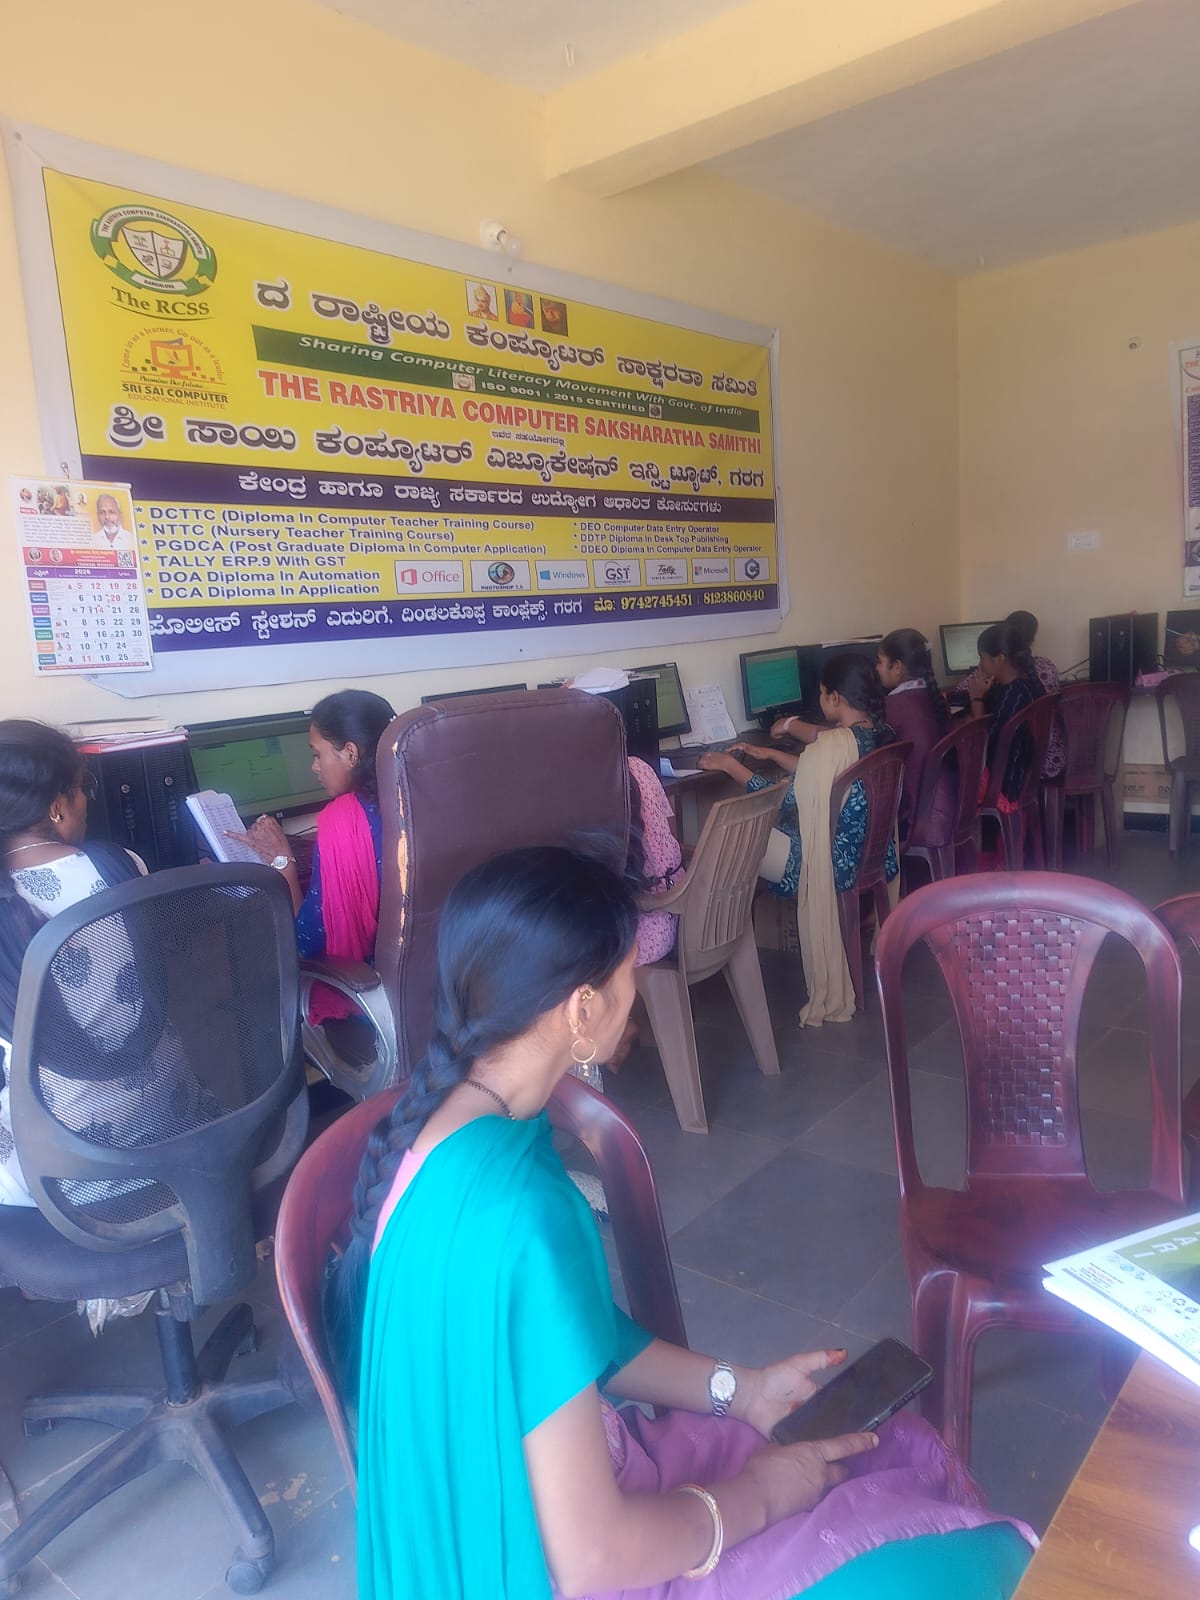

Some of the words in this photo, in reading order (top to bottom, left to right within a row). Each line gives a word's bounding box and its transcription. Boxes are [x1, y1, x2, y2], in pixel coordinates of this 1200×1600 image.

[111, 286, 150, 310] The
[156, 299, 210, 316] RCSS
[257, 280, 290, 310] ದ
[312, 293, 450, 344] ರಾಷ್ಟ್ರೀಯ
[466, 322, 605, 371] ಕಂಪ್ಯೂಟರ್
[617, 356, 704, 389] ಸಾಕ್ಷರತಾ
[712, 373, 757, 396] ಸಮಿತಿ
[299, 336, 384, 361] Sharing
[390, 352, 483, 375] Computer
[488, 367, 551, 386] Literacy
[555, 380, 631, 399] Movement
[636, 388, 665, 404] With
[668, 398, 697, 410] Govt.
[700, 405, 713, 414] of
[715, 406, 742, 416] India
[122, 384, 142, 393] SRI
[145, 385, 164, 396] SAI
[167, 389, 228, 403] COMPUTER
[128, 393, 184, 405] EDUCATIONAL
[481, 382, 506, 391] ISO
[511, 386, 541, 397] 9001
[554, 393, 583, 403] 2015
[587, 398, 646, 413] CERTIFIED
[258, 370, 321, 402] THE
[328, 380, 456, 420] RASTRIYA
[463, 400, 578, 433] COMPUTER
[585, 416, 705, 448] SAKSHARATHA
[709, 432, 761, 454] SAMITHI
[110, 406, 164, 447] ಶ್ರೀ
[186, 420, 296, 450] ಸಾಯಿ
[316, 426, 473, 473] ಕಂಪ್ಯೂಟರ್
[729, 468, 764, 487] ಗರಗ
[238, 470, 307, 499] ಕೇಂದ್ರ
[318, 479, 383, 498] ಹಾಗೂ
[394, 484, 441, 508] ರಾಜ್ಯ
[450, 485, 523, 505] ಸರ್ಕಾರದ
[531, 491, 596, 514] ಉದ್ಯೋಗ
[150, 507, 216, 521] DCTTC
[222, 510, 294, 524] (Diploma
[300, 513, 312, 523] In
[318, 513, 385, 528] Computer
[390, 516, 439, 528] Teacher
[442, 518, 489, 530] Training
[492, 520, 534, 531] Course)
[152, 524, 204, 536] NTTC
[211, 526, 280, 540] (Nursery
[285, 527, 344, 539] Teacher
[349, 528, 403, 541] Training
[406, 529, 454, 542] Course)
[580, 522, 601, 531] DEO
[604, 523, 644, 534] Computer
[646, 524, 663, 532] Data
[666, 525, 686, 534] Entry
[687, 525, 719, 535] Operator
[580, 534, 606, 542] DDTP
[609, 534, 643, 544] Diploma
[676, 535, 689, 545] Top
[691, 535, 729, 545] Publishing
[155, 540, 225, 552] PGDCA
[230, 541, 272, 553] (Post
[276, 541, 345, 553] Graduate
[349, 542, 405, 554] Diploma
[408, 544, 420, 553] In
[424, 544, 480, 556] Computer
[484, 544, 546, 556] Application)
[580, 545, 609, 553] DDEO
[611, 545, 645, 555] Diploma
[647, 545, 654, 553] In
[657, 545, 693, 555] Computer
[696, 545, 712, 553] Data
[713, 545, 731, 554] Entry
[733, 545, 761, 554] Operator
[156, 556, 216, 568] TALLY
[222, 556, 271, 567] ERP.9
[275, 556, 310, 567] With
[315, 556, 346, 567] GST
[657, 564, 677, 575] Tally
[158, 572, 202, 583] DOA
[207, 571, 275, 584] Diploma
[280, 570, 294, 581] In
[298, 570, 380, 581] Automation
[422, 570, 460, 583] Office
[552, 571, 585, 579] Windows
[606, 566, 630, 580] GST
[704, 566, 728, 575] Microsoft
[161, 588, 202, 599] DCA
[208, 586, 276, 599] Diploma
[280, 585, 294, 596] In
[299, 584, 379, 597] Application
[554, 599, 583, 615] ಗರಗ
[621, 594, 693, 610] 9742745451
[704, 589, 765, 605] 8123860840
